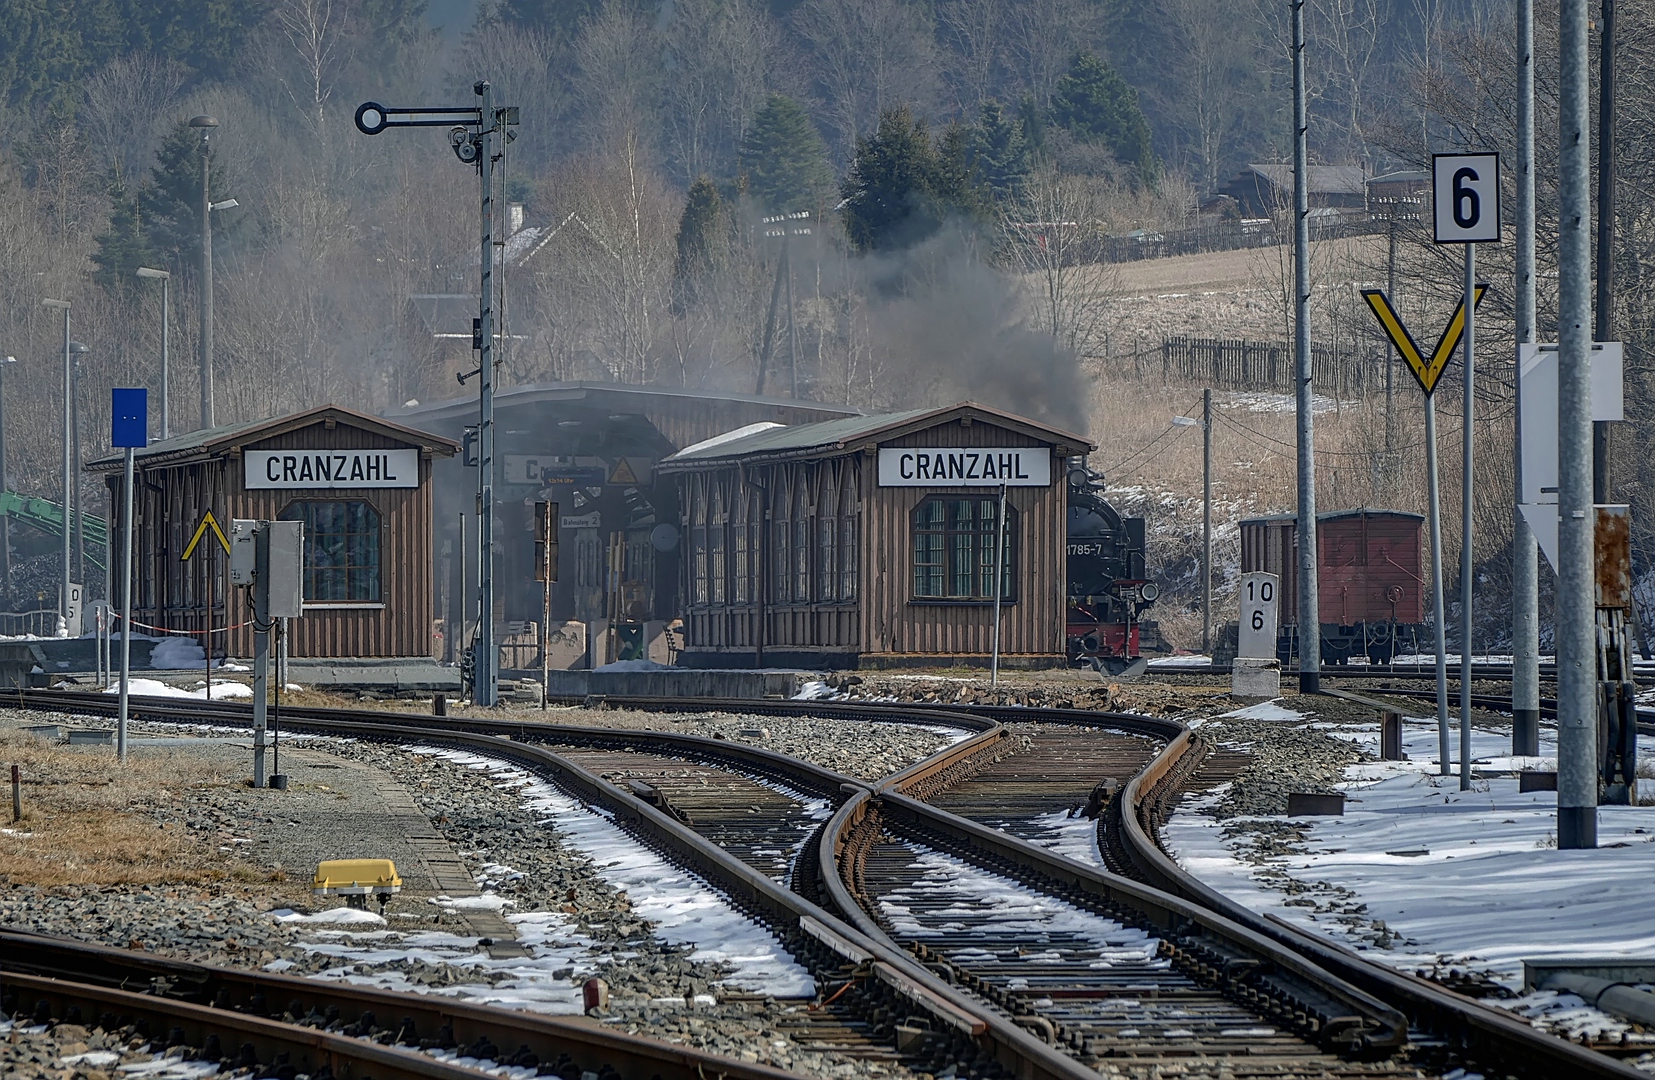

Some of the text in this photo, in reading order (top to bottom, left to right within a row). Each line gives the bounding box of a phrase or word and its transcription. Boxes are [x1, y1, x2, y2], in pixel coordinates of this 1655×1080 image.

[1452, 166, 1480, 229] 6
[266, 455, 397, 482] CRANZAHL
[900, 453, 1029, 480] CRANZAHL
[592, 516, 598, 525] 2
[1066, 544, 1102, 555] 1785-7
[1247, 581, 1273, 602] 10
[1252, 610, 1264, 630] 6
